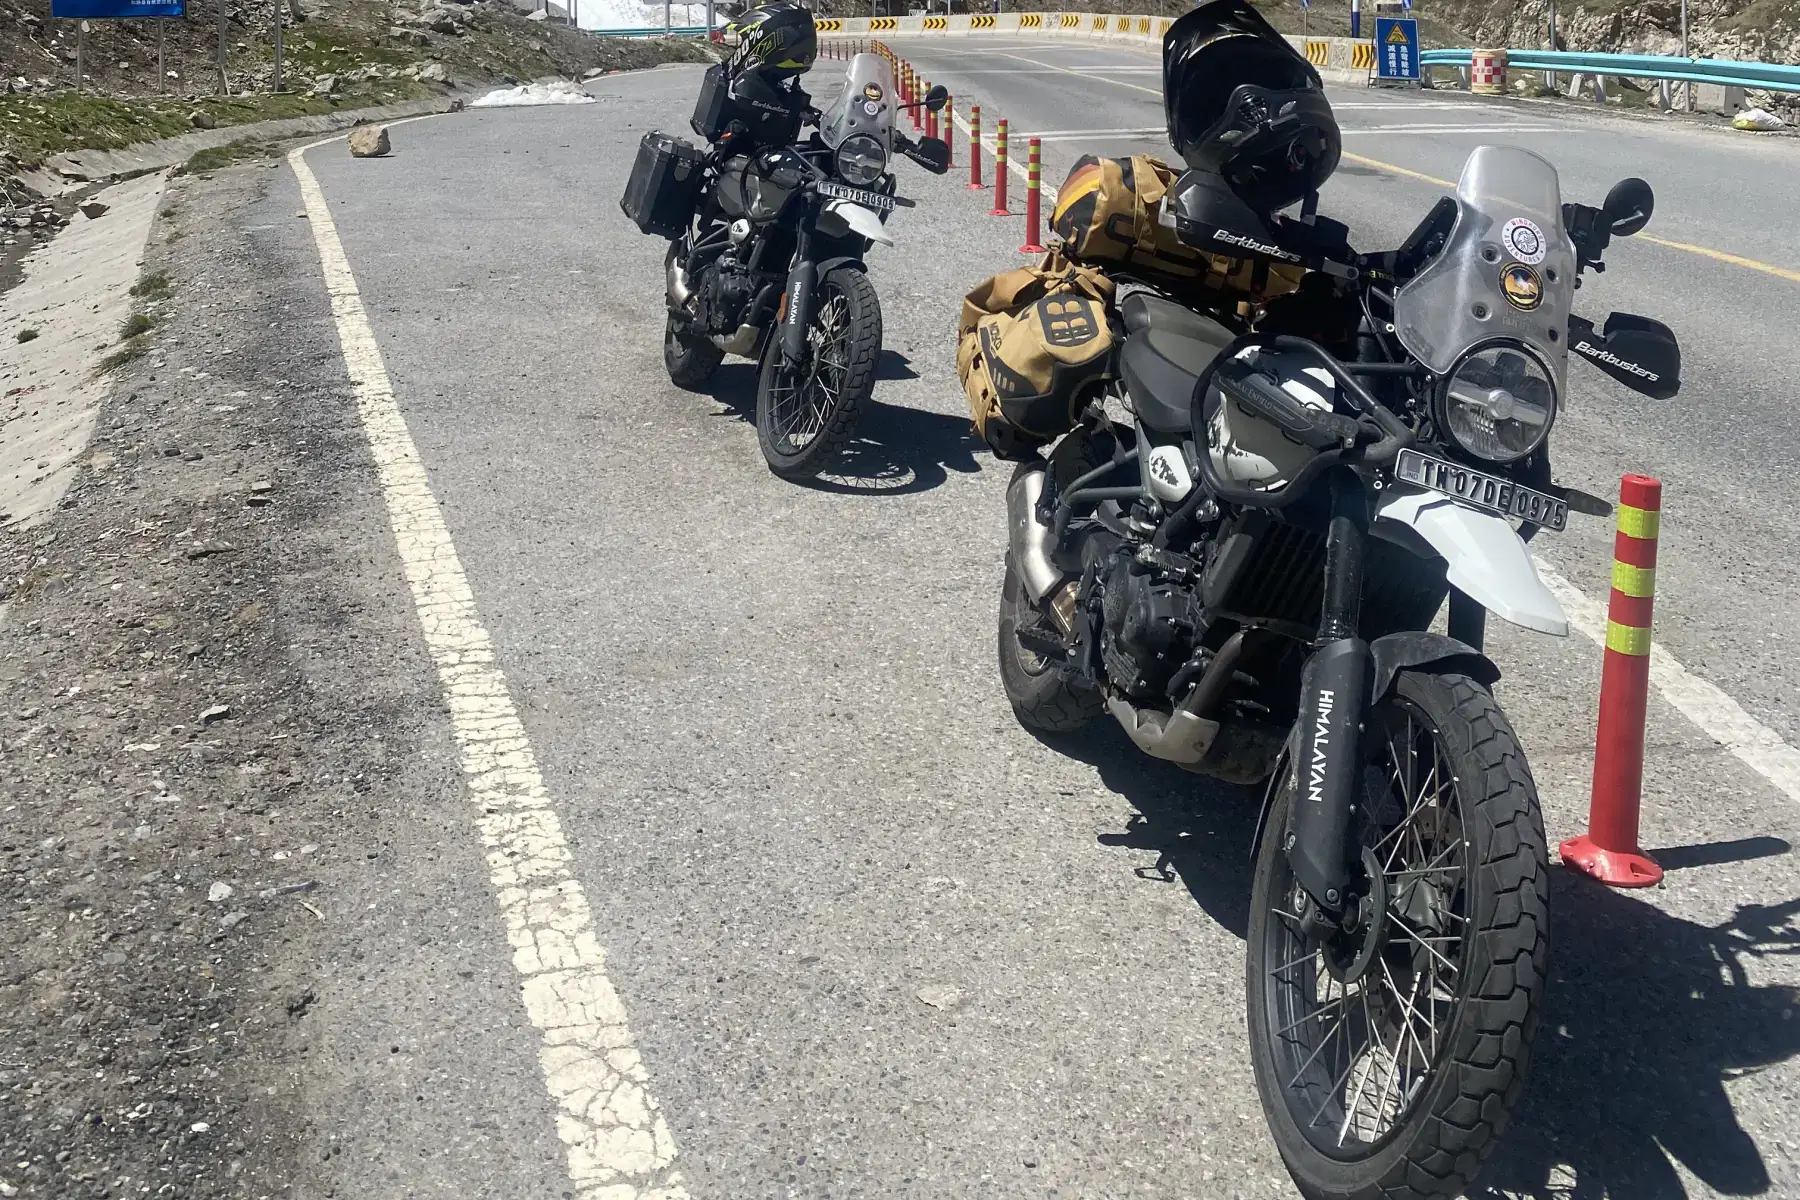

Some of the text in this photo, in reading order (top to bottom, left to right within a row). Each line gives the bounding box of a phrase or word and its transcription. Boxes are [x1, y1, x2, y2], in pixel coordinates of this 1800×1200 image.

[1387, 44, 1397, 76] 减速慢行
[1213, 229, 1302, 263] Barkbusters
[789, 281, 802, 325] HIMALAYAN
[1574, 341, 1660, 382] Barkbusters
[1307, 689, 1335, 802] HIMALAYAN
